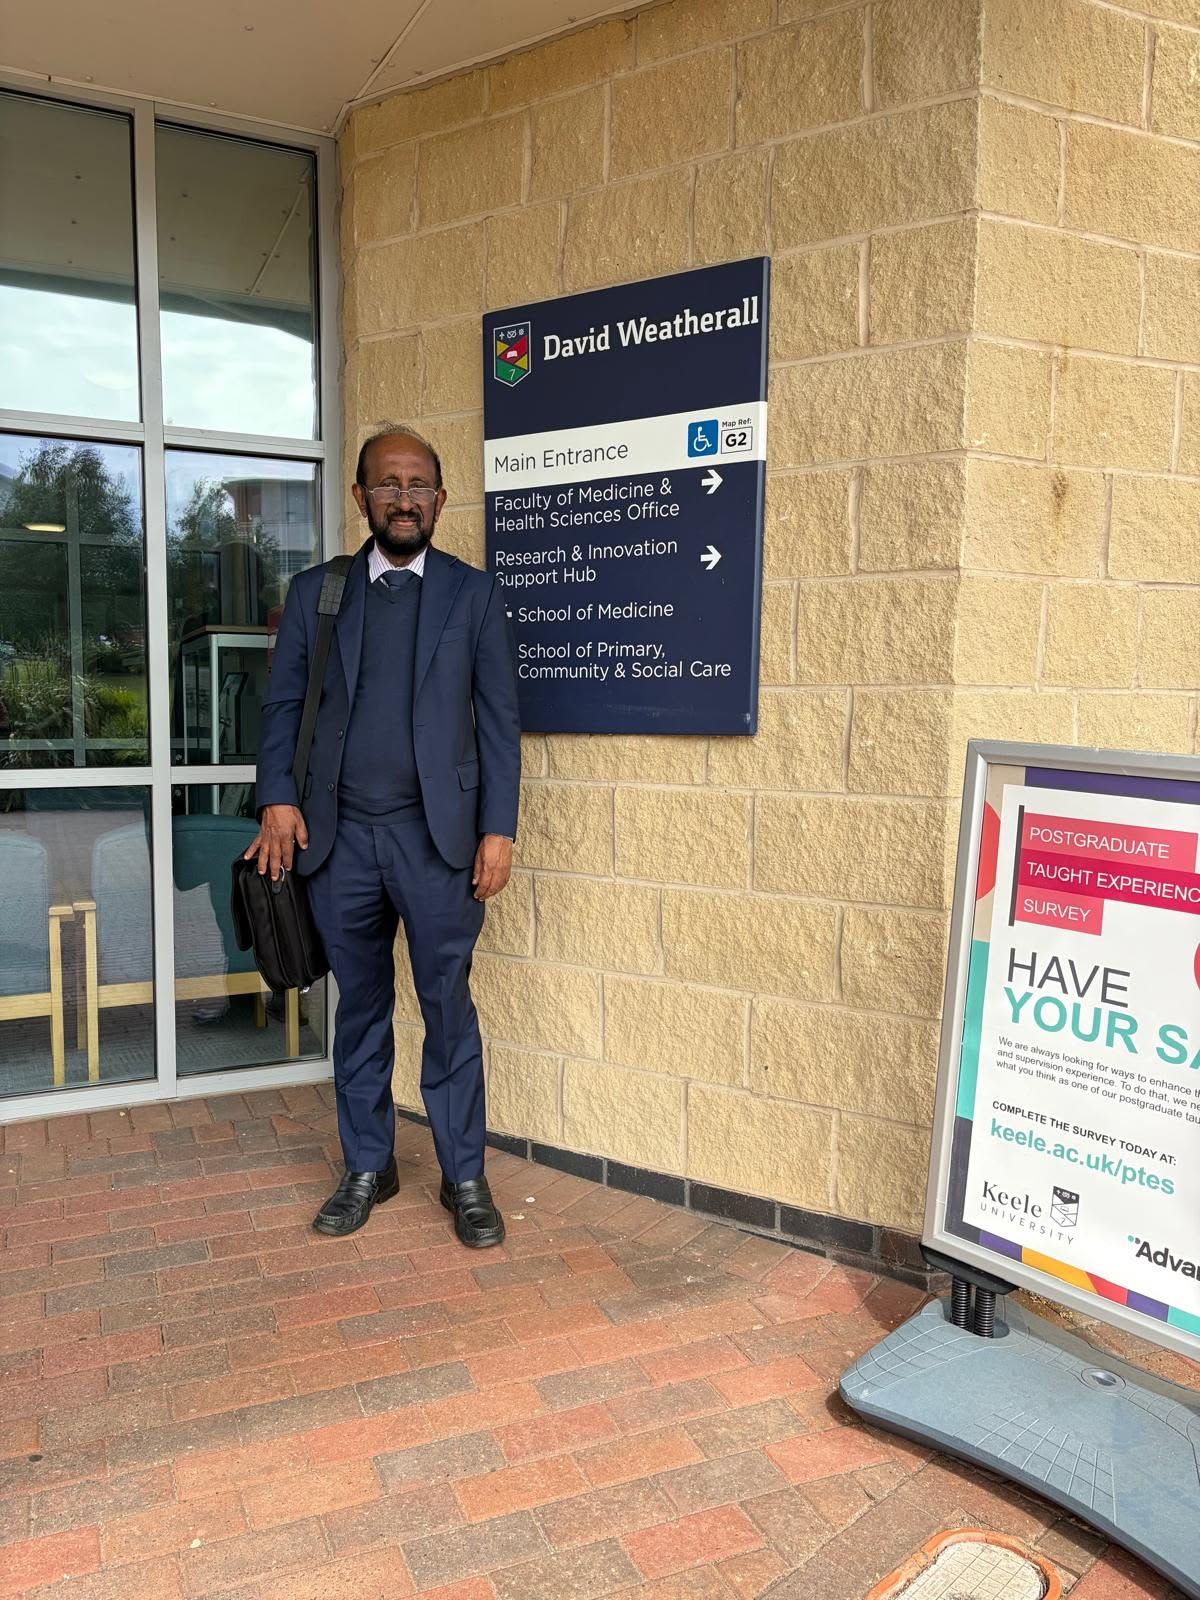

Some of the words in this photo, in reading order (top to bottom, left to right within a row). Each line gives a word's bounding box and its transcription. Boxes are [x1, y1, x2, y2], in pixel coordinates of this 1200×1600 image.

[543, 324, 611, 361] David
[616, 295, 759, 348] Weatherall
[721, 420, 737, 428] Map
[738, 417, 752, 426] Ref:
[725, 432, 747, 447] G2
[494, 451, 536, 474] Main
[543, 443, 629, 468] Entrance
[495, 491, 551, 512] Faculty
[557, 488, 574, 506] of
[578, 481, 654, 504] Medicine
[660, 477, 672, 495] &
[495, 513, 545, 532] Health
[550, 506, 621, 528] Sciences
[627, 501, 680, 520] Office
[495, 547, 566, 567] Research
[571, 545, 583, 562] &
[588, 538, 678, 560] Innovation
[495, 569, 558, 588] Support
[563, 566, 597, 583] Hub
[518, 604, 571, 623] School
[576, 603, 594, 621] of
[598, 600, 674, 620] Medicine
[518, 642, 570, 659] School
[575, 641, 592, 658] of
[597, 641, 666, 660] Primary,
[518, 662, 609, 682] Community
[614, 662, 626, 678] &
[631, 661, 683, 678] Social
[690, 660, 732, 678] Care
[1029, 827, 1170, 859] POSTGRADUATE
[1026, 861, 1093, 886] TAUGHT
[1023, 899, 1092, 922] SURVEY
[1007, 947, 1130, 1008] HAVE
[1003, 986, 1139, 1054] YOUR
[997, 1049, 1013, 1059] and
[1015, 1054, 1063, 1072] supervision
[1120, 1080, 1132, 1091] To
[1134, 1085, 1146, 1095] do
[1148, 1089, 1170, 1103] that,
[1173, 1096, 1187, 1107] we
[998, 1035, 1013, 1047] We
[1014, 1042, 1029, 1052] are
[1030, 1046, 1060, 1060] always
[1062, 1053, 1094, 1070] looking
[1096, 1062, 1109, 1072] for
[1111, 1067, 1135, 1080] ways
[1137, 1073, 1147, 1083] to
[1149, 1078, 1192, 1095] enhance
[996, 1060, 1016, 1071] what
[1018, 1066, 1033, 1076] you
[1036, 1070, 1056, 1082] think
[1058, 1077, 1069, 1086] as
[1071, 1081, 1088, 1091] one
[1090, 1086, 1100, 1094] of
[1101, 1089, 1117, 1099] our
[1119, 1094, 1183, 1118] postgraduate
[992, 1100, 1047, 1125] COMPLETE
[1049, 1117, 1070, 1132] THE
[1072, 1125, 1117, 1146] SURVEY
[1119, 1140, 1158, 1159] TODAY
[1159, 1153, 1177, 1166] AT:
[990, 1117, 1175, 1195] keele.ac.uk/ptes
[982, 1180, 1042, 1218] Keele
[979, 1201, 1075, 1245] UNIVERSITY
